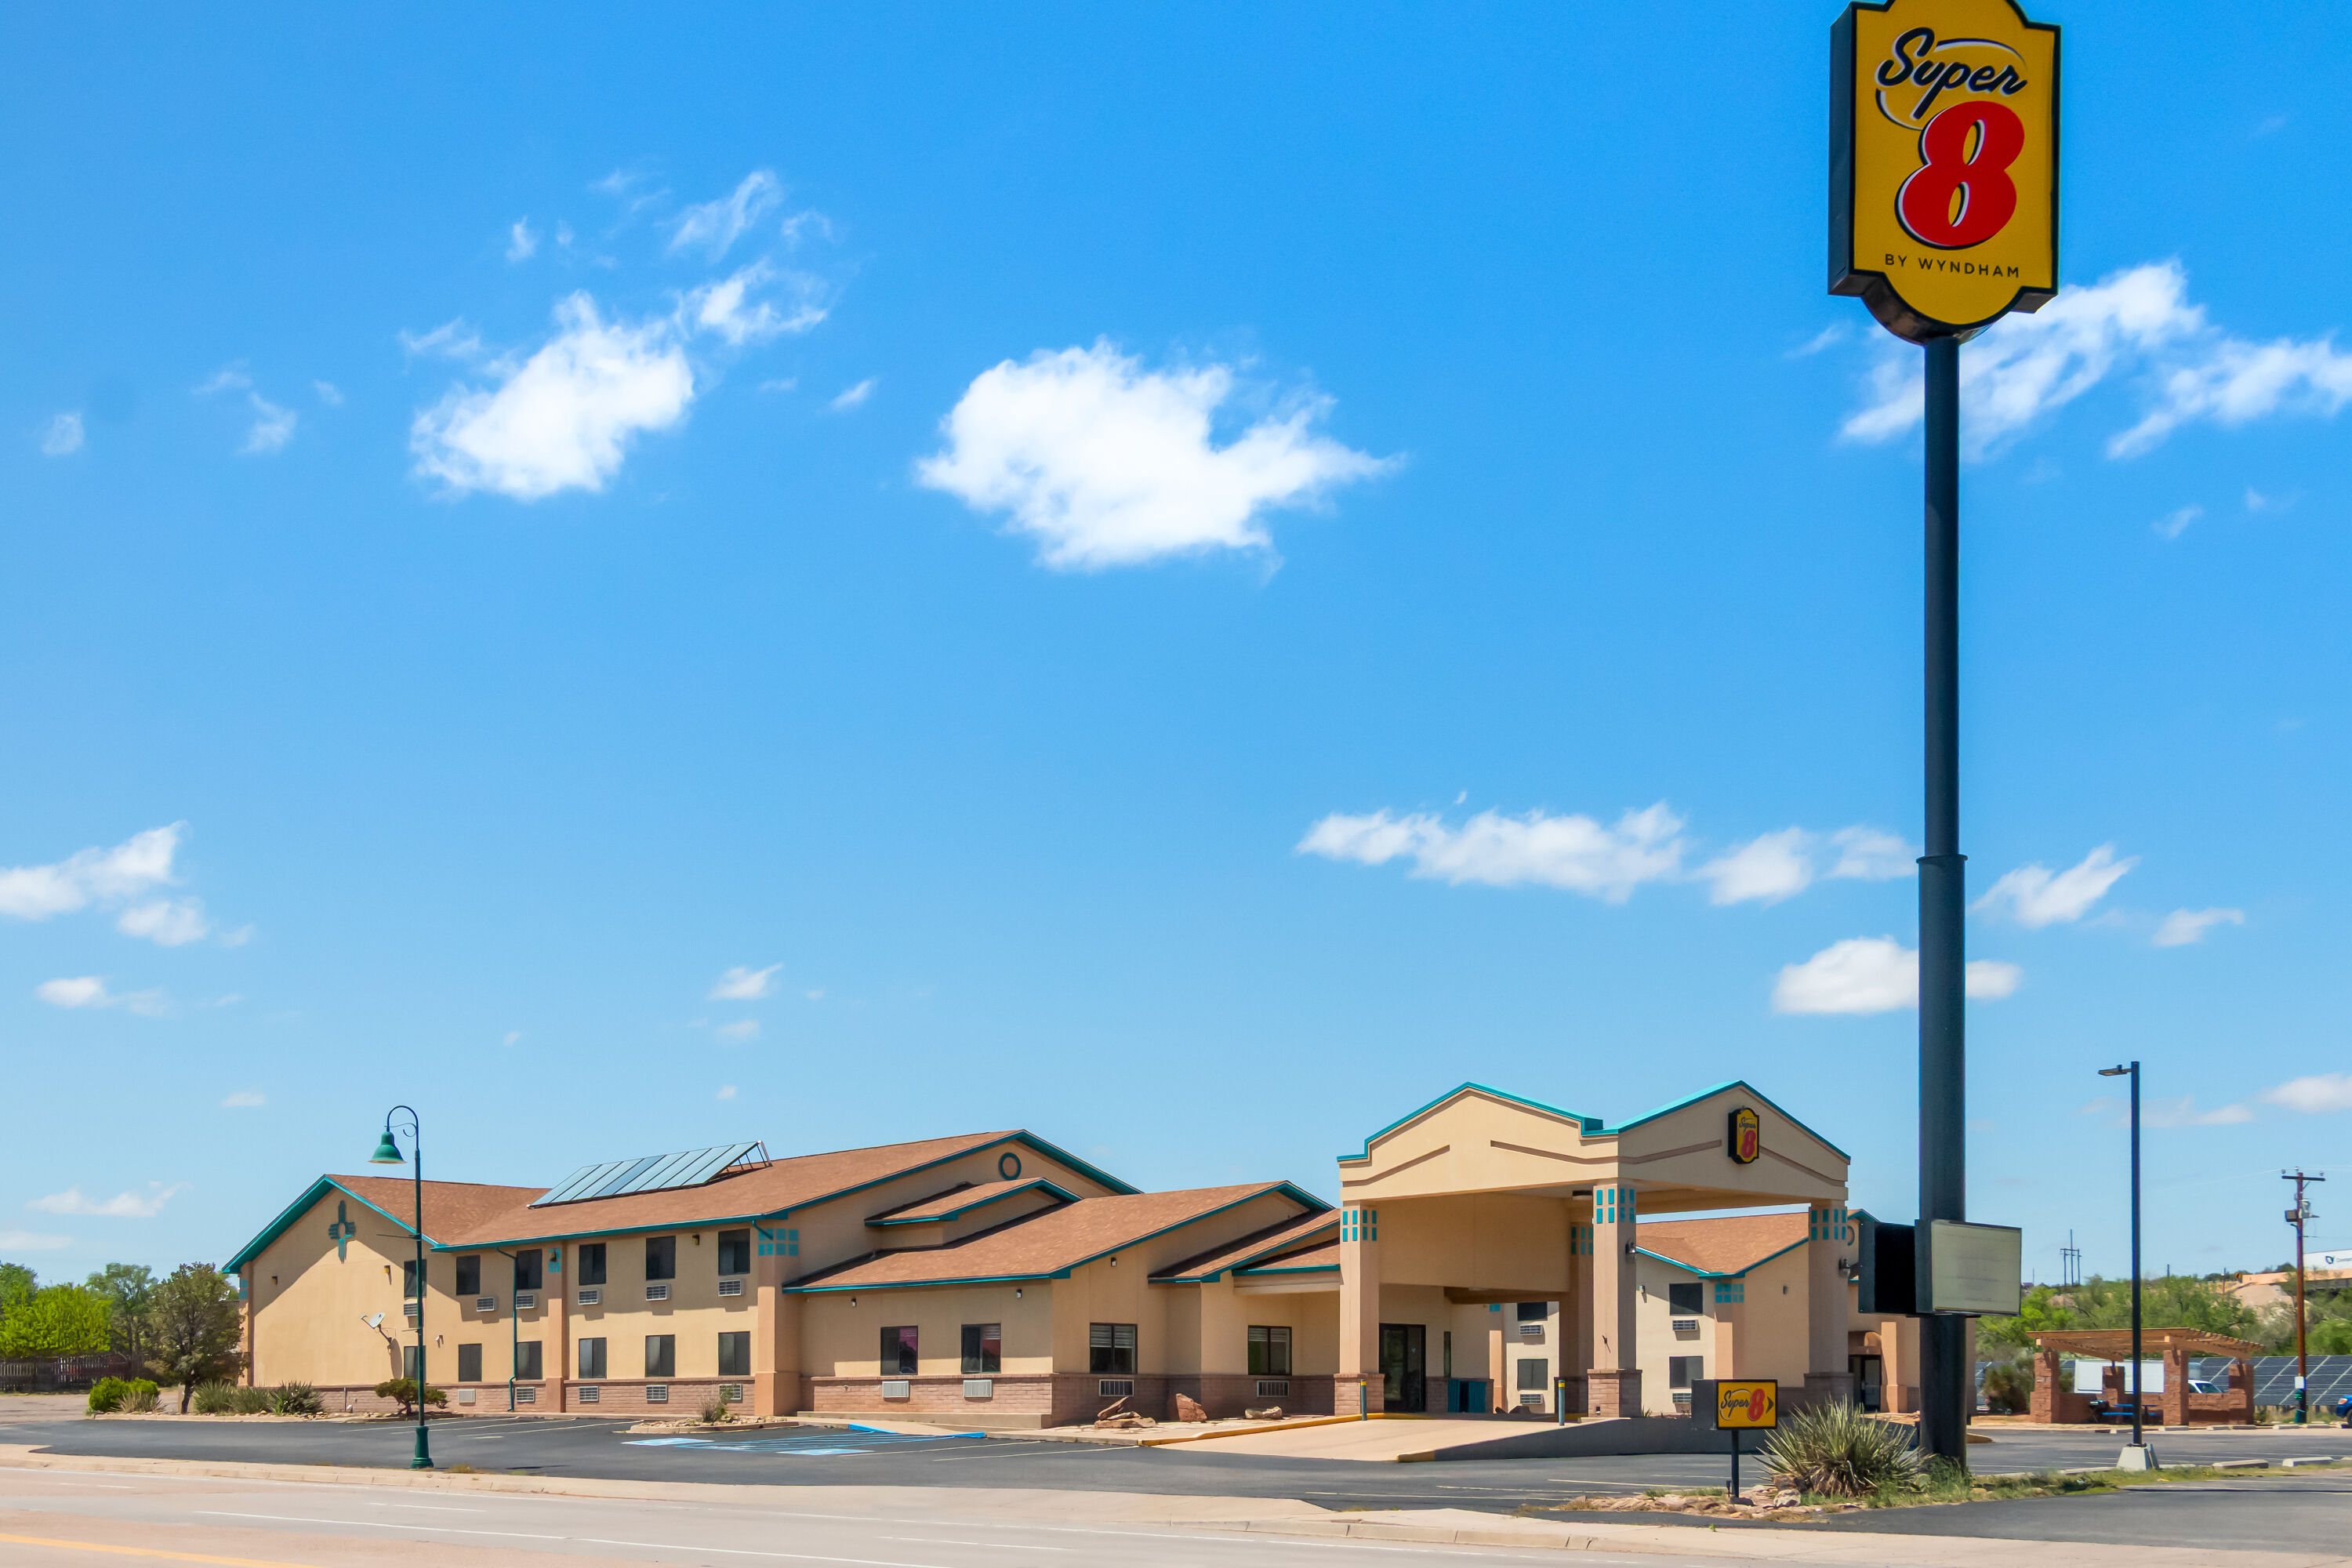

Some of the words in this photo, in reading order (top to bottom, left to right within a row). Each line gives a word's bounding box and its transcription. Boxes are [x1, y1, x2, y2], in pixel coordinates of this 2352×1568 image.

[1875, 27, 2027, 122] Super
[1894, 100, 2025, 251] 8
[1885, 253, 1907, 267] BY
[1918, 257, 2020, 278] WYNDHAM
[1740, 1130, 1757, 1159] 8
[1720, 1390, 1750, 1418] Super
[1748, 1388, 1766, 1421] 8
